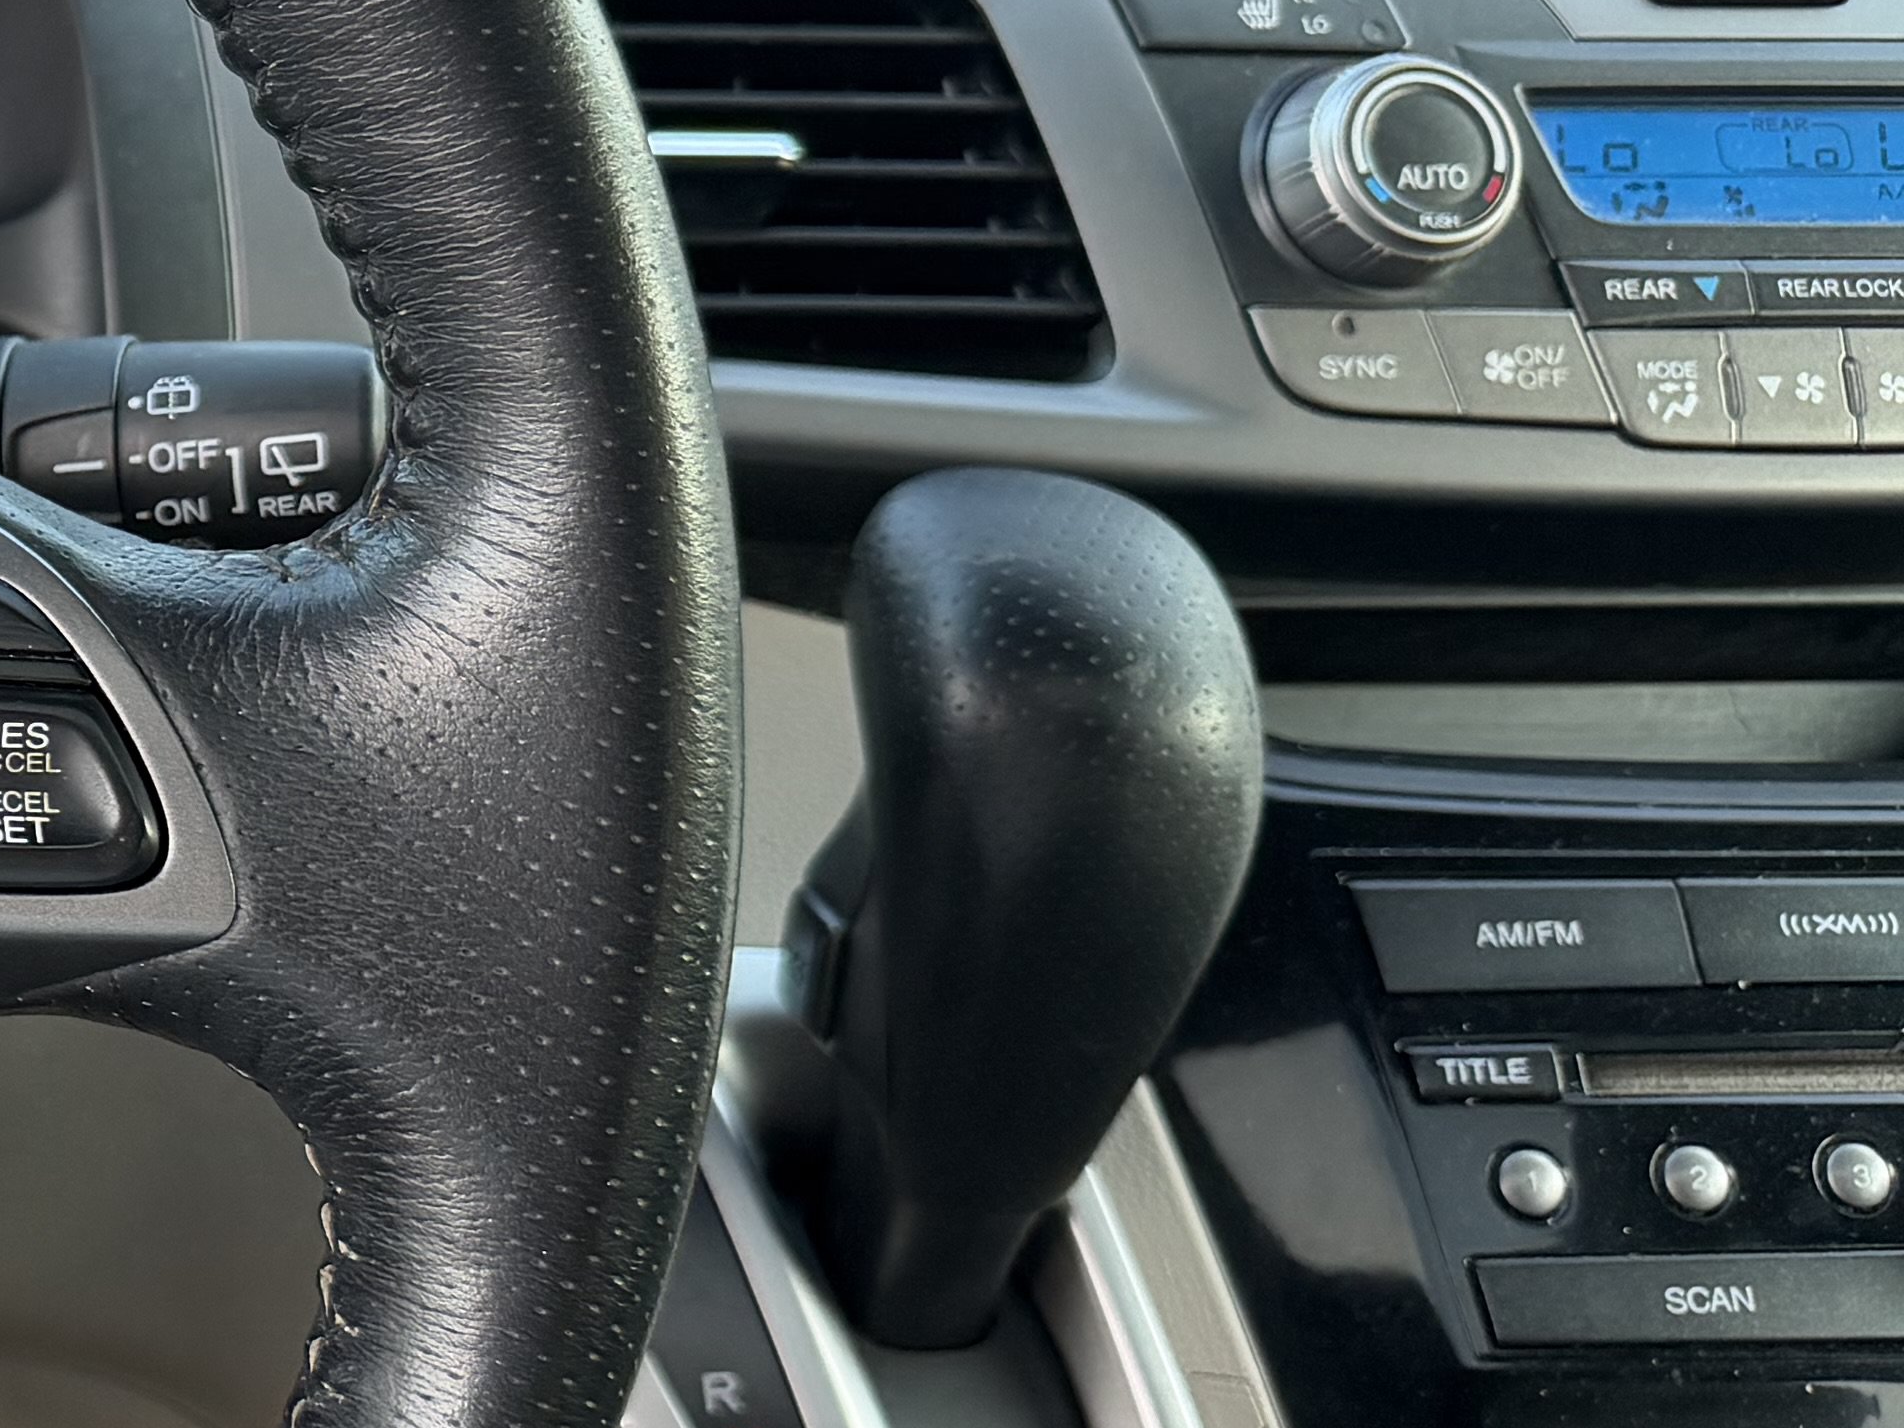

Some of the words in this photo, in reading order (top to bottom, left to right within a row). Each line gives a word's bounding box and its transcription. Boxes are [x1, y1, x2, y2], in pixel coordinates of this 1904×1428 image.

[1397, 163, 1470, 193] AUTO
[1604, 277, 1679, 303] REAR
[1777, 277, 1841, 300] REAR
[1843, 277, 1904, 299] LOCK
[1318, 355, 1399, 380] SYNC
[1517, 367, 1569, 391] OFF
[1637, 360, 1699, 381] MODE
[147, 442, 221, 473] OFF
[154, 497, 211, 527] ON
[258, 492, 337, 518] REAR
[1475, 920, 1585, 949] AM/FM
[1436, 1057, 1533, 1085] TITLE
[1689, 1163, 1709, 1191] 2
[1852, 1162, 1873, 1190] 3
[1663, 1285, 1757, 1316] SCAN
[700, 1371, 747, 1415] R
